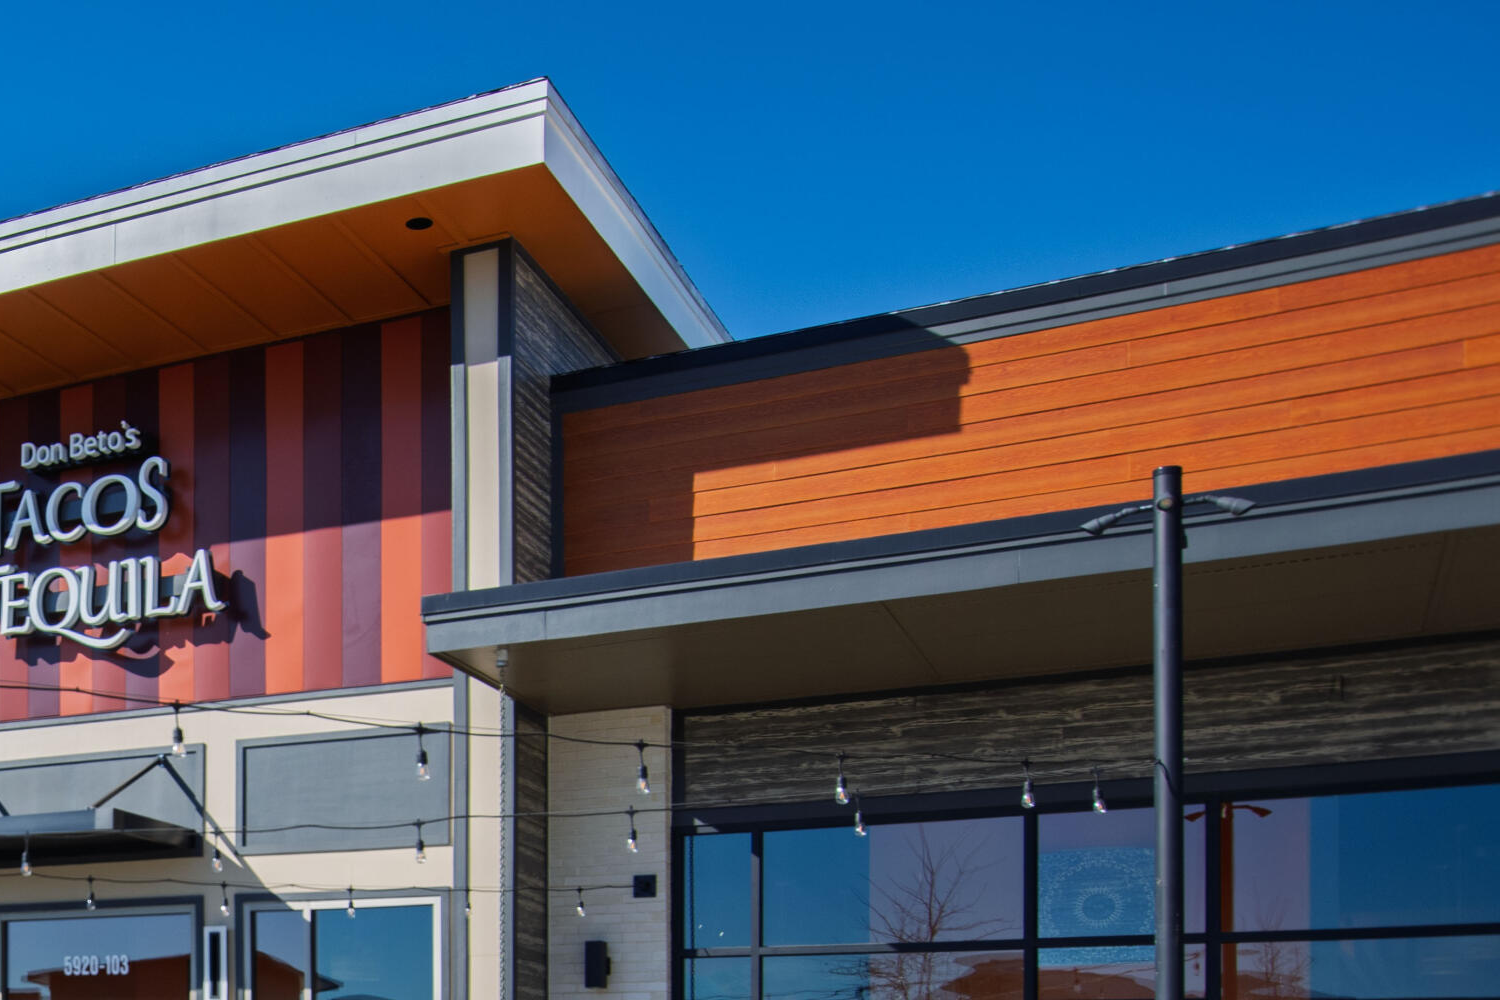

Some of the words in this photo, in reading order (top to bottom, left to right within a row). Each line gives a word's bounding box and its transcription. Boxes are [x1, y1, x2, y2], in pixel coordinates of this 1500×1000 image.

[21, 442, 68, 469] Don
[69, 420, 142, 460] Beto's
[63, 955, 130, 976] 5920-103
